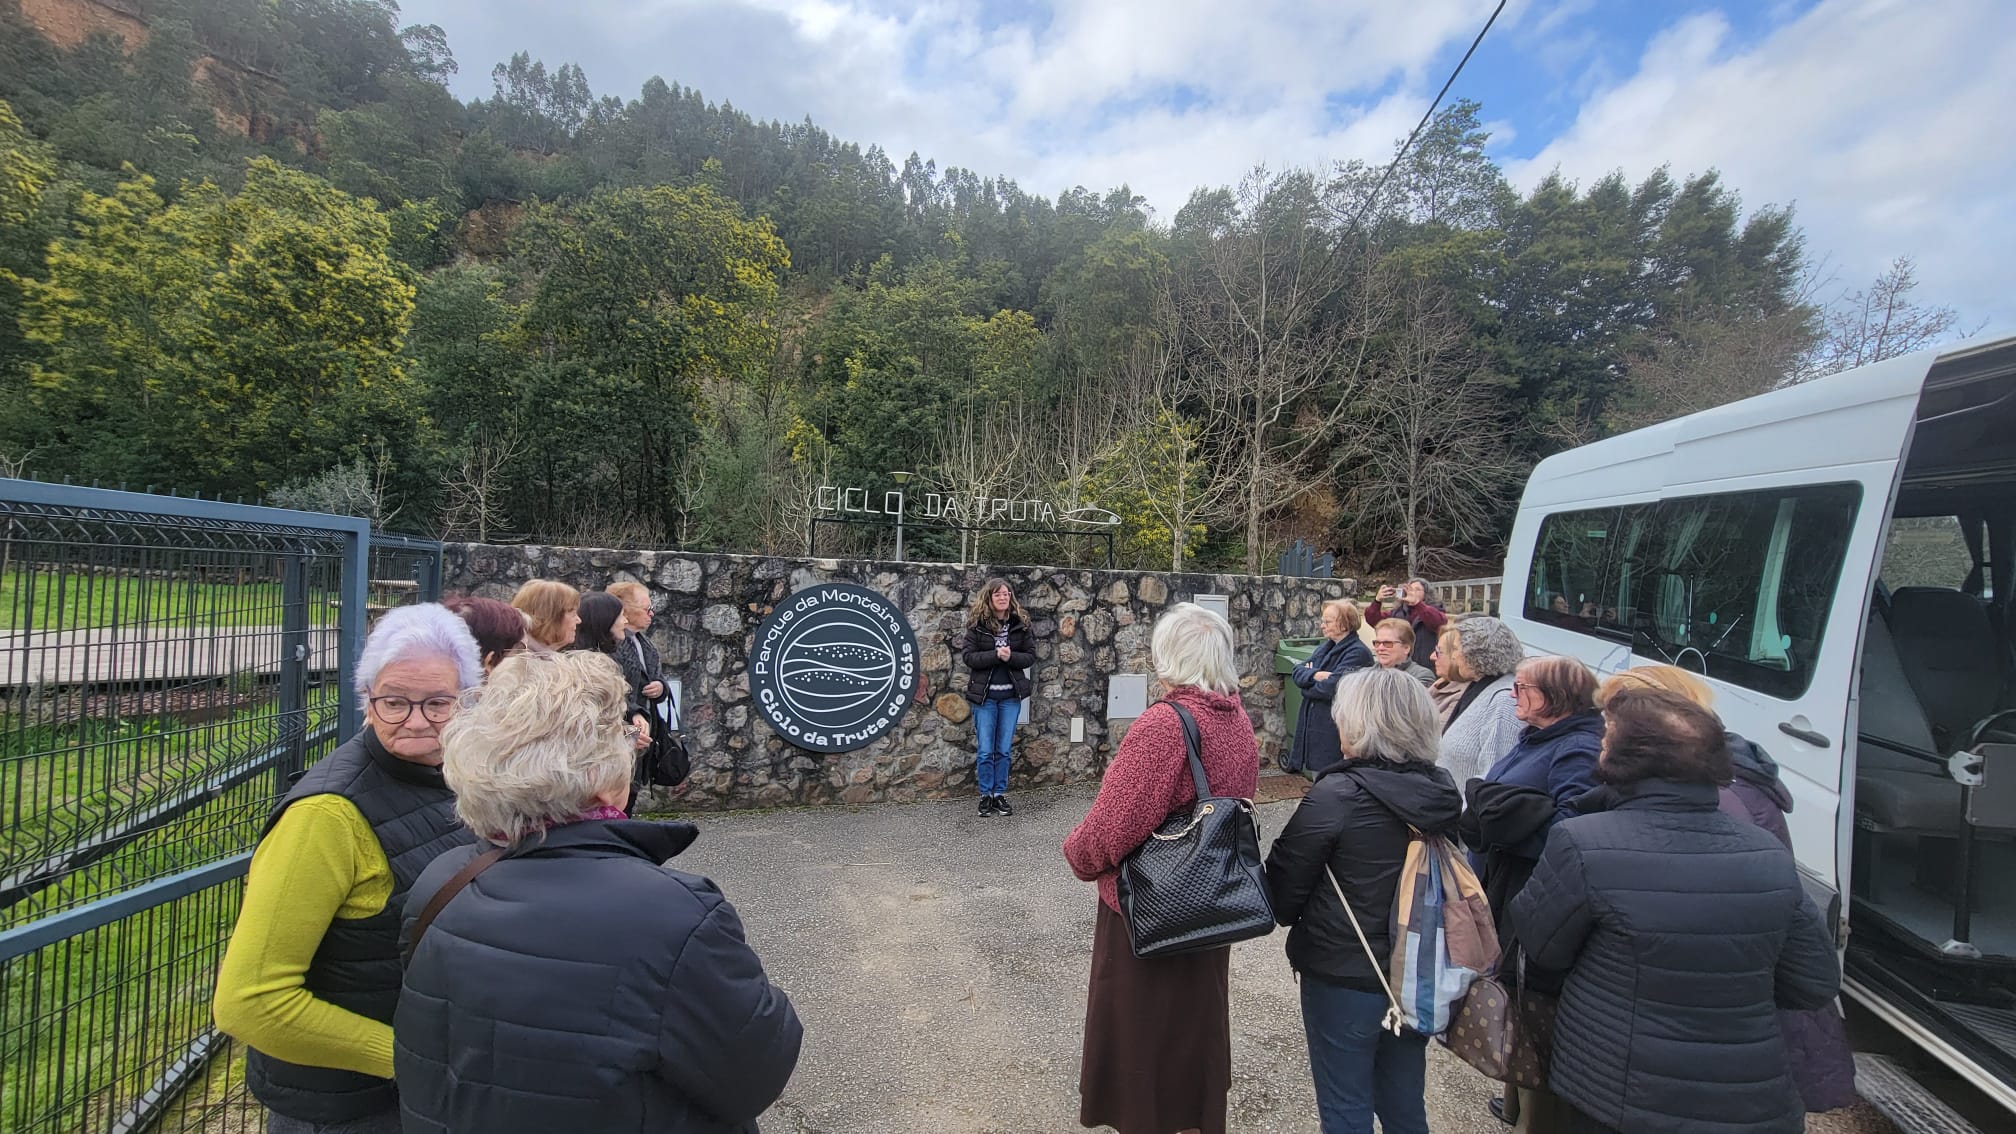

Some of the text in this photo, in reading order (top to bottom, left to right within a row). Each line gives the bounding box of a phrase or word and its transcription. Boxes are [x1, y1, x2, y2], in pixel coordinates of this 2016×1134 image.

[818, 486, 1056, 523] CICLO DA TRUTA
[755, 589, 901, 675] Parque da Monteira
[760, 643, 914, 747] Ciclo da Truta de Góis
